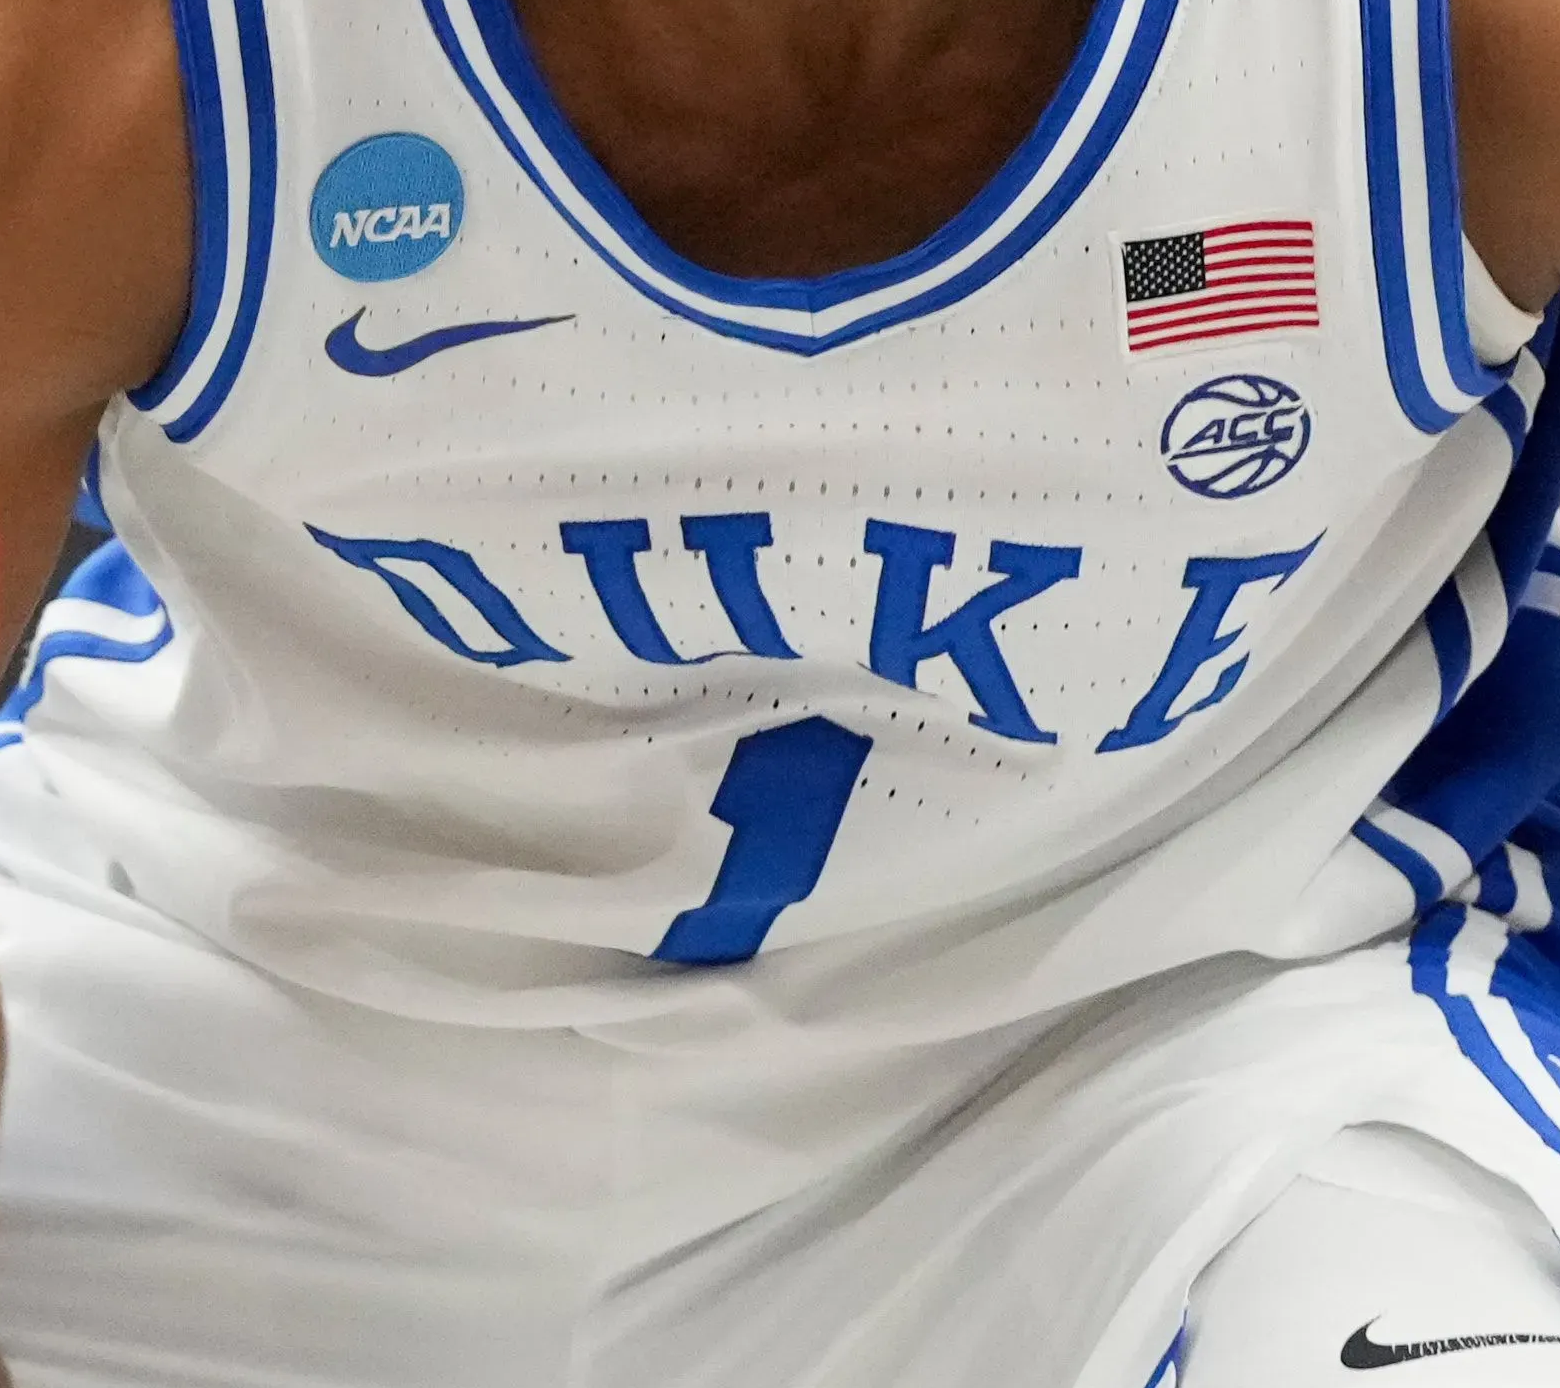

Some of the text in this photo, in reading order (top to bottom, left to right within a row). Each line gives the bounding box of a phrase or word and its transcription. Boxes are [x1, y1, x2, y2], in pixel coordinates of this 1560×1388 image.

[329, 202, 452, 248] NCAA
[1181, 404, 1303, 451] ACC
[302, 511, 1328, 755] DUKE
[645, 713, 875, 966] 1
